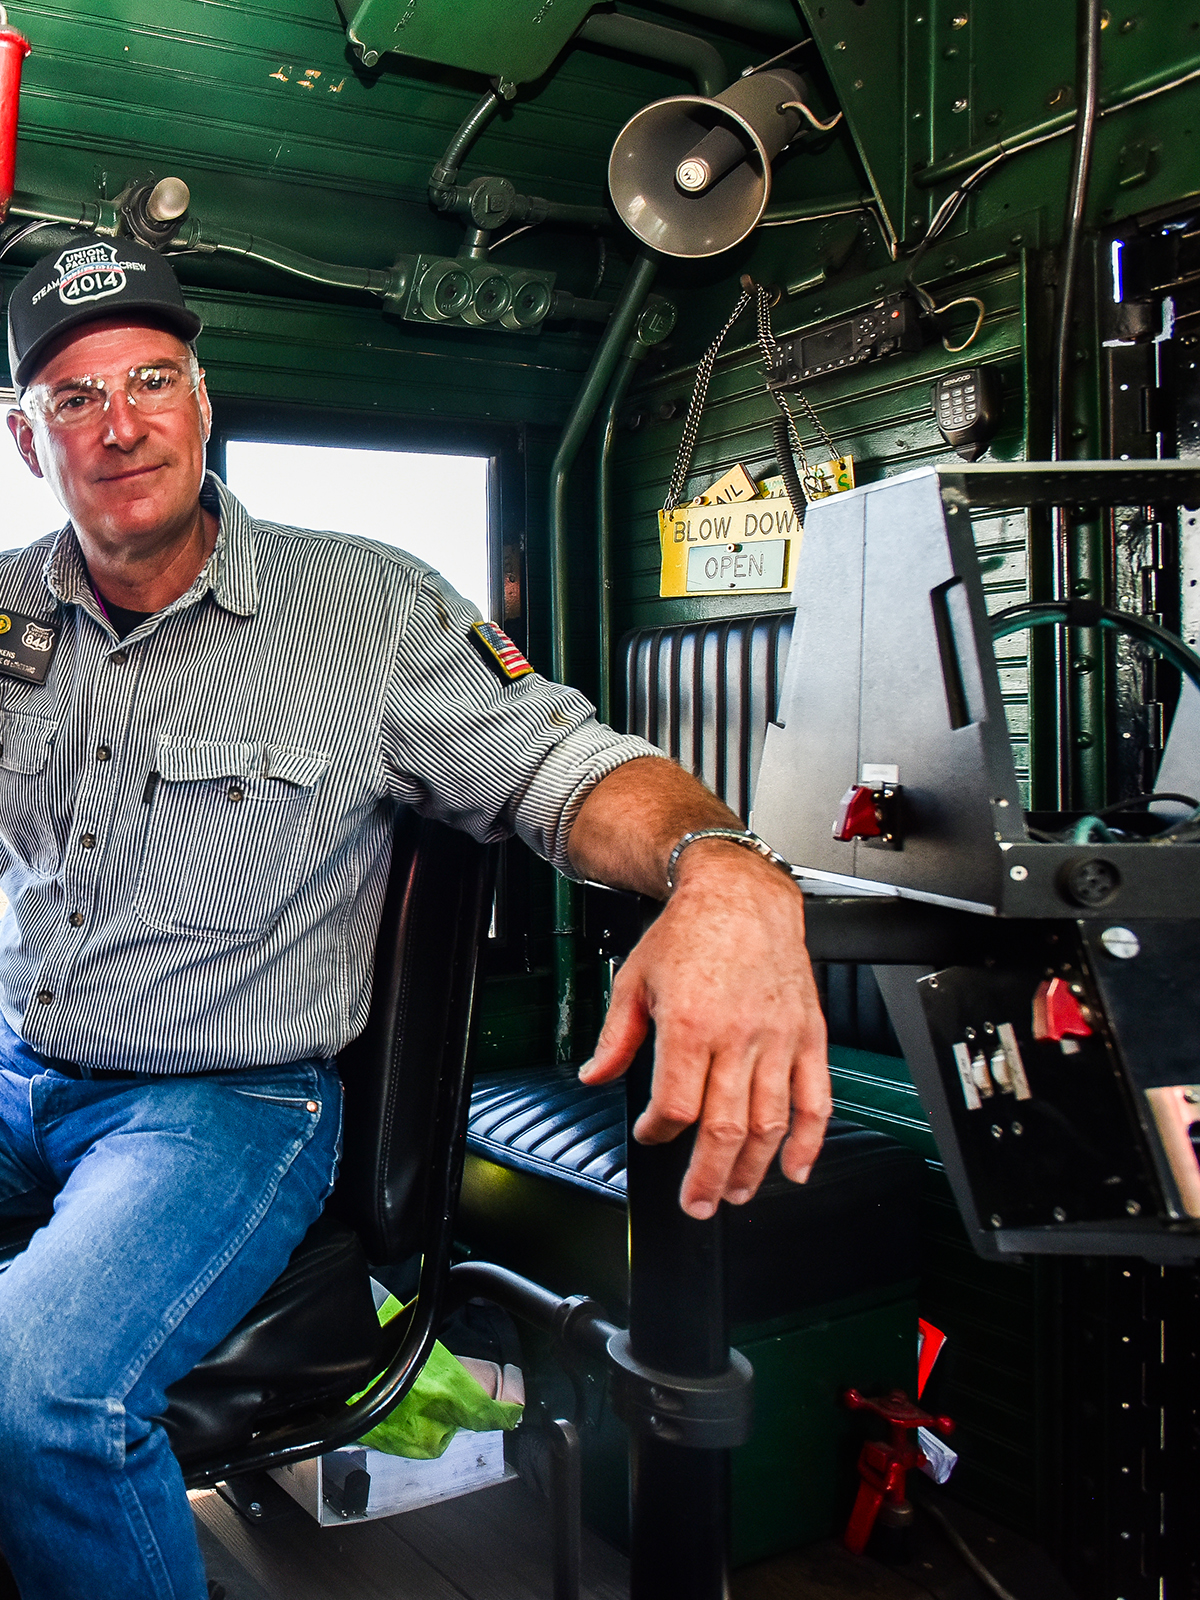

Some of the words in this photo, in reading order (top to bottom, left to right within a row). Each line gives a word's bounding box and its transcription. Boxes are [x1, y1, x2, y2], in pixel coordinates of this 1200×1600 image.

[65, 254, 110, 272] PACIFIC
[66, 247, 105, 263] UNION
[31, 278, 61, 306] STEAM
[119, 261, 147, 272] CREW
[66, 271, 118, 298] 4014
[708, 484, 744, 504] AIL
[673, 515, 732, 543] BLOW
[704, 553, 764, 580] OPEN
[25, 634, 48, 650] 844
